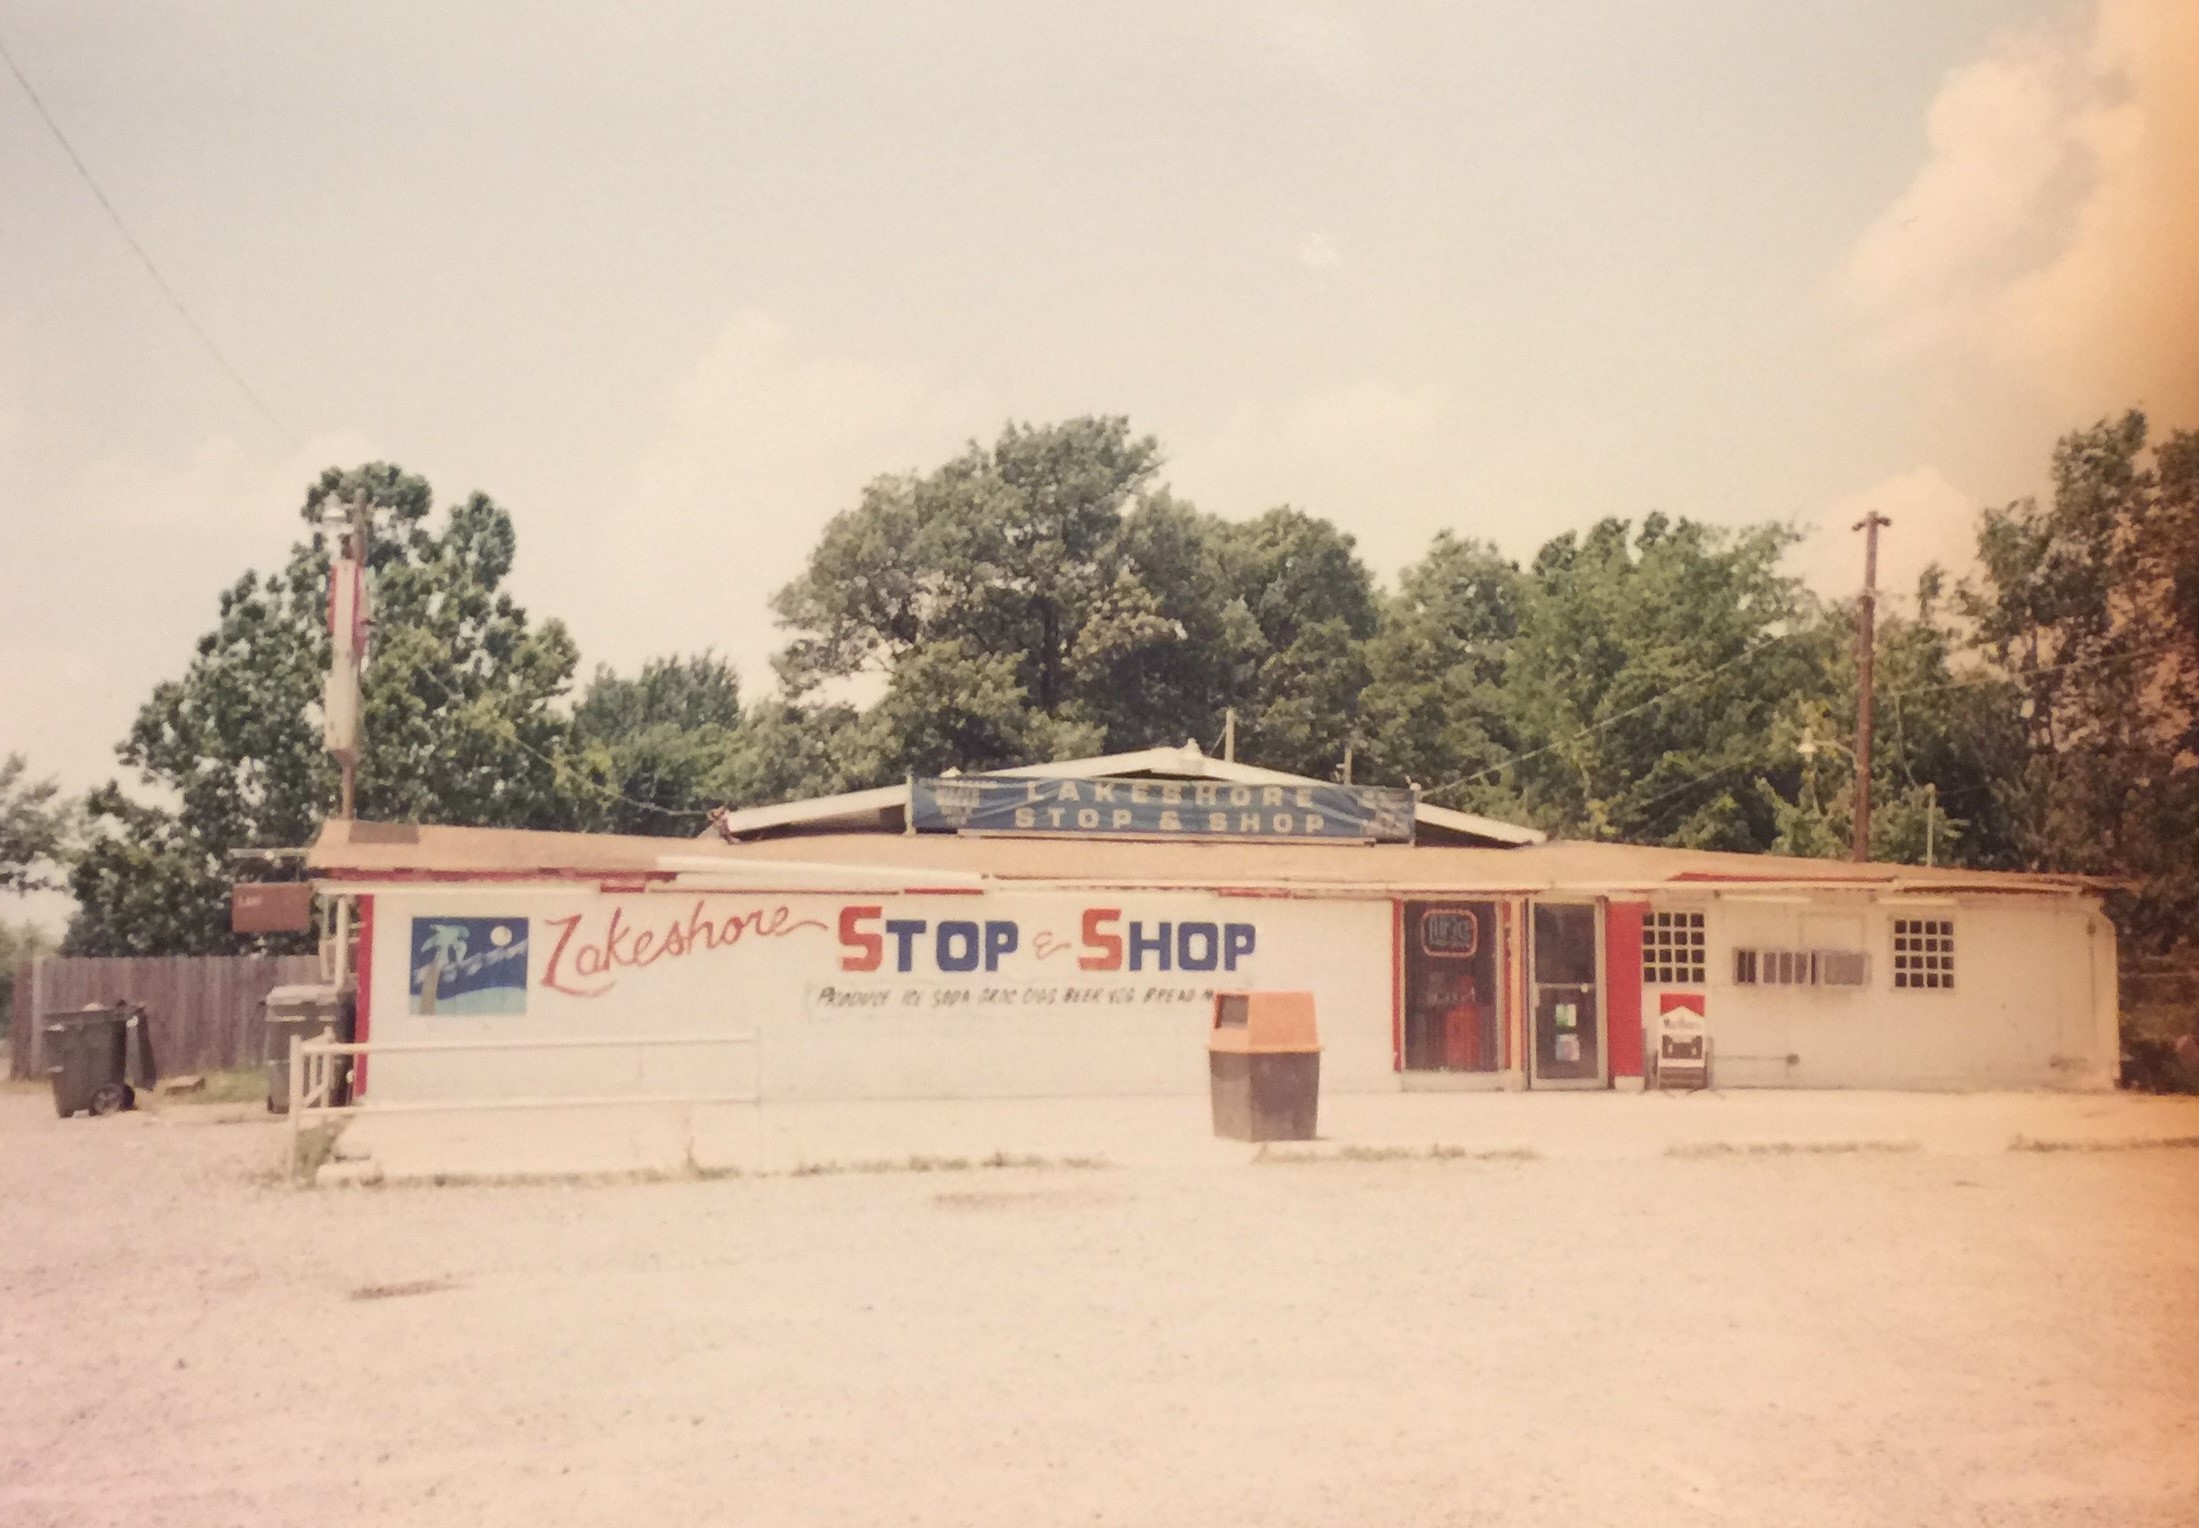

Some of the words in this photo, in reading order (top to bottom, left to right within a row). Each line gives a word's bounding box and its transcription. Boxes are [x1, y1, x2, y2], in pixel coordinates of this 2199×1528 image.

[1026, 781, 1312, 808] LAKESHORE
[1015, 807, 1132, 829] STOP
[1159, 810, 1182, 831] &
[1209, 812, 1325, 834] SHOP
[541, 900, 828, 998] Lakeshore
[838, 905, 1019, 973] STOP
[1032, 929, 1071, 961] &
[1078, 908, 1257, 973] SHOP
[931, 988, 970, 1008] SODA
[1063, 986, 1104, 1004] BEER
